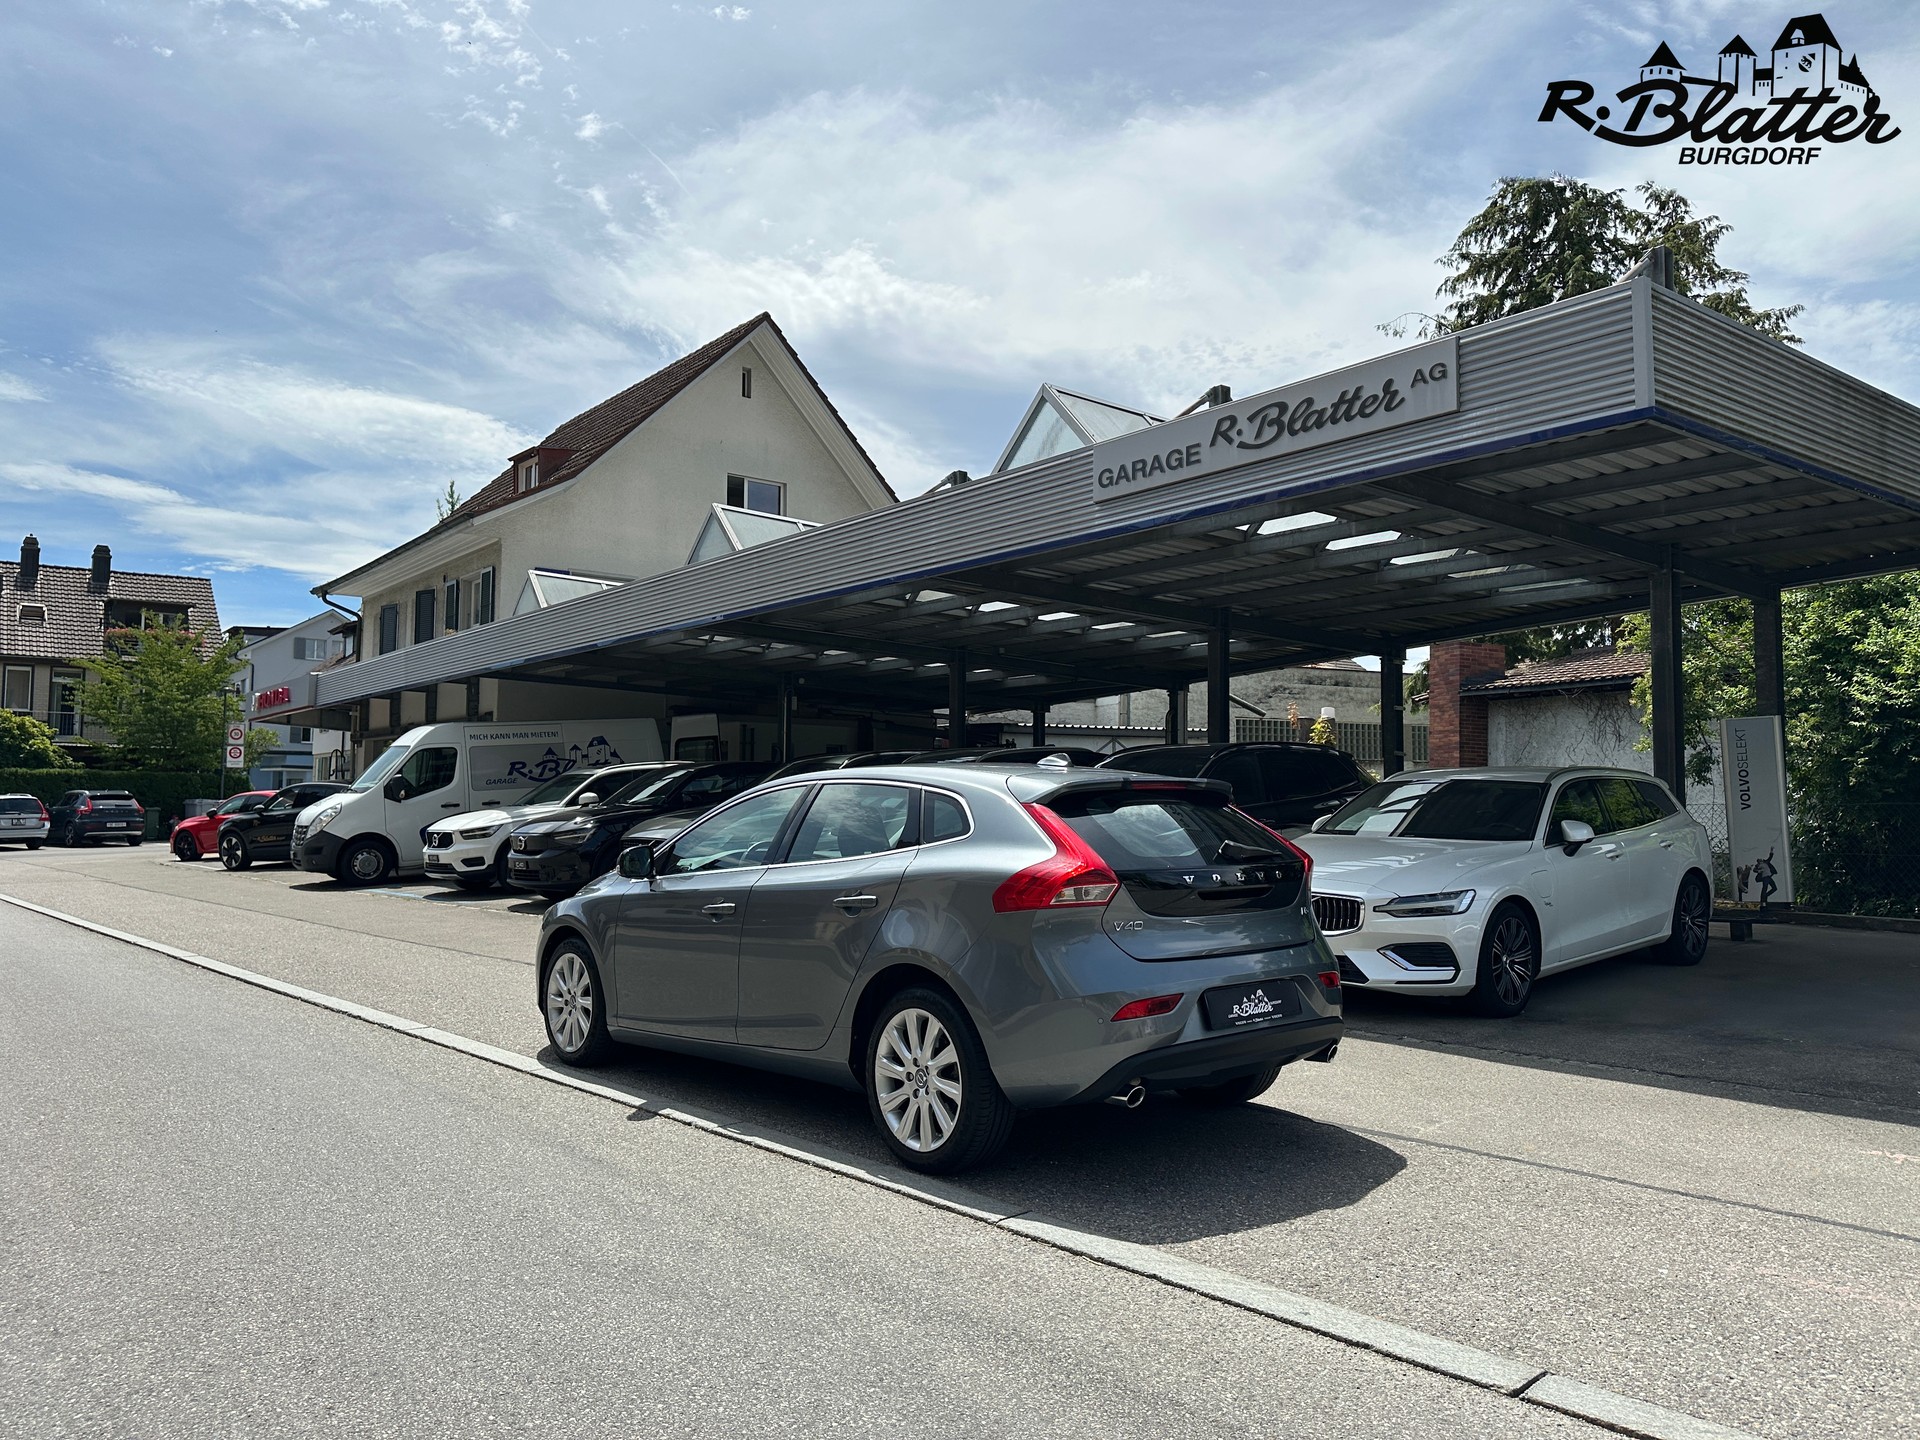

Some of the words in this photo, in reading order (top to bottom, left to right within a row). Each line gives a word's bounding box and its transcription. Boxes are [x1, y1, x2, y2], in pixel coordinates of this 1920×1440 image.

[1097, 443, 1202, 489] GARAGE
[1409, 362, 1448, 389] AG
[469, 733, 489, 741] MICH
[490, 732, 511, 740] KANN
[1735, 727, 1751, 811] VOLVOSELEKT
[485, 778, 518, 786] GARAGE
[1183, 870, 1282, 884] VOLVO
[1113, 920, 1144, 932] V40
